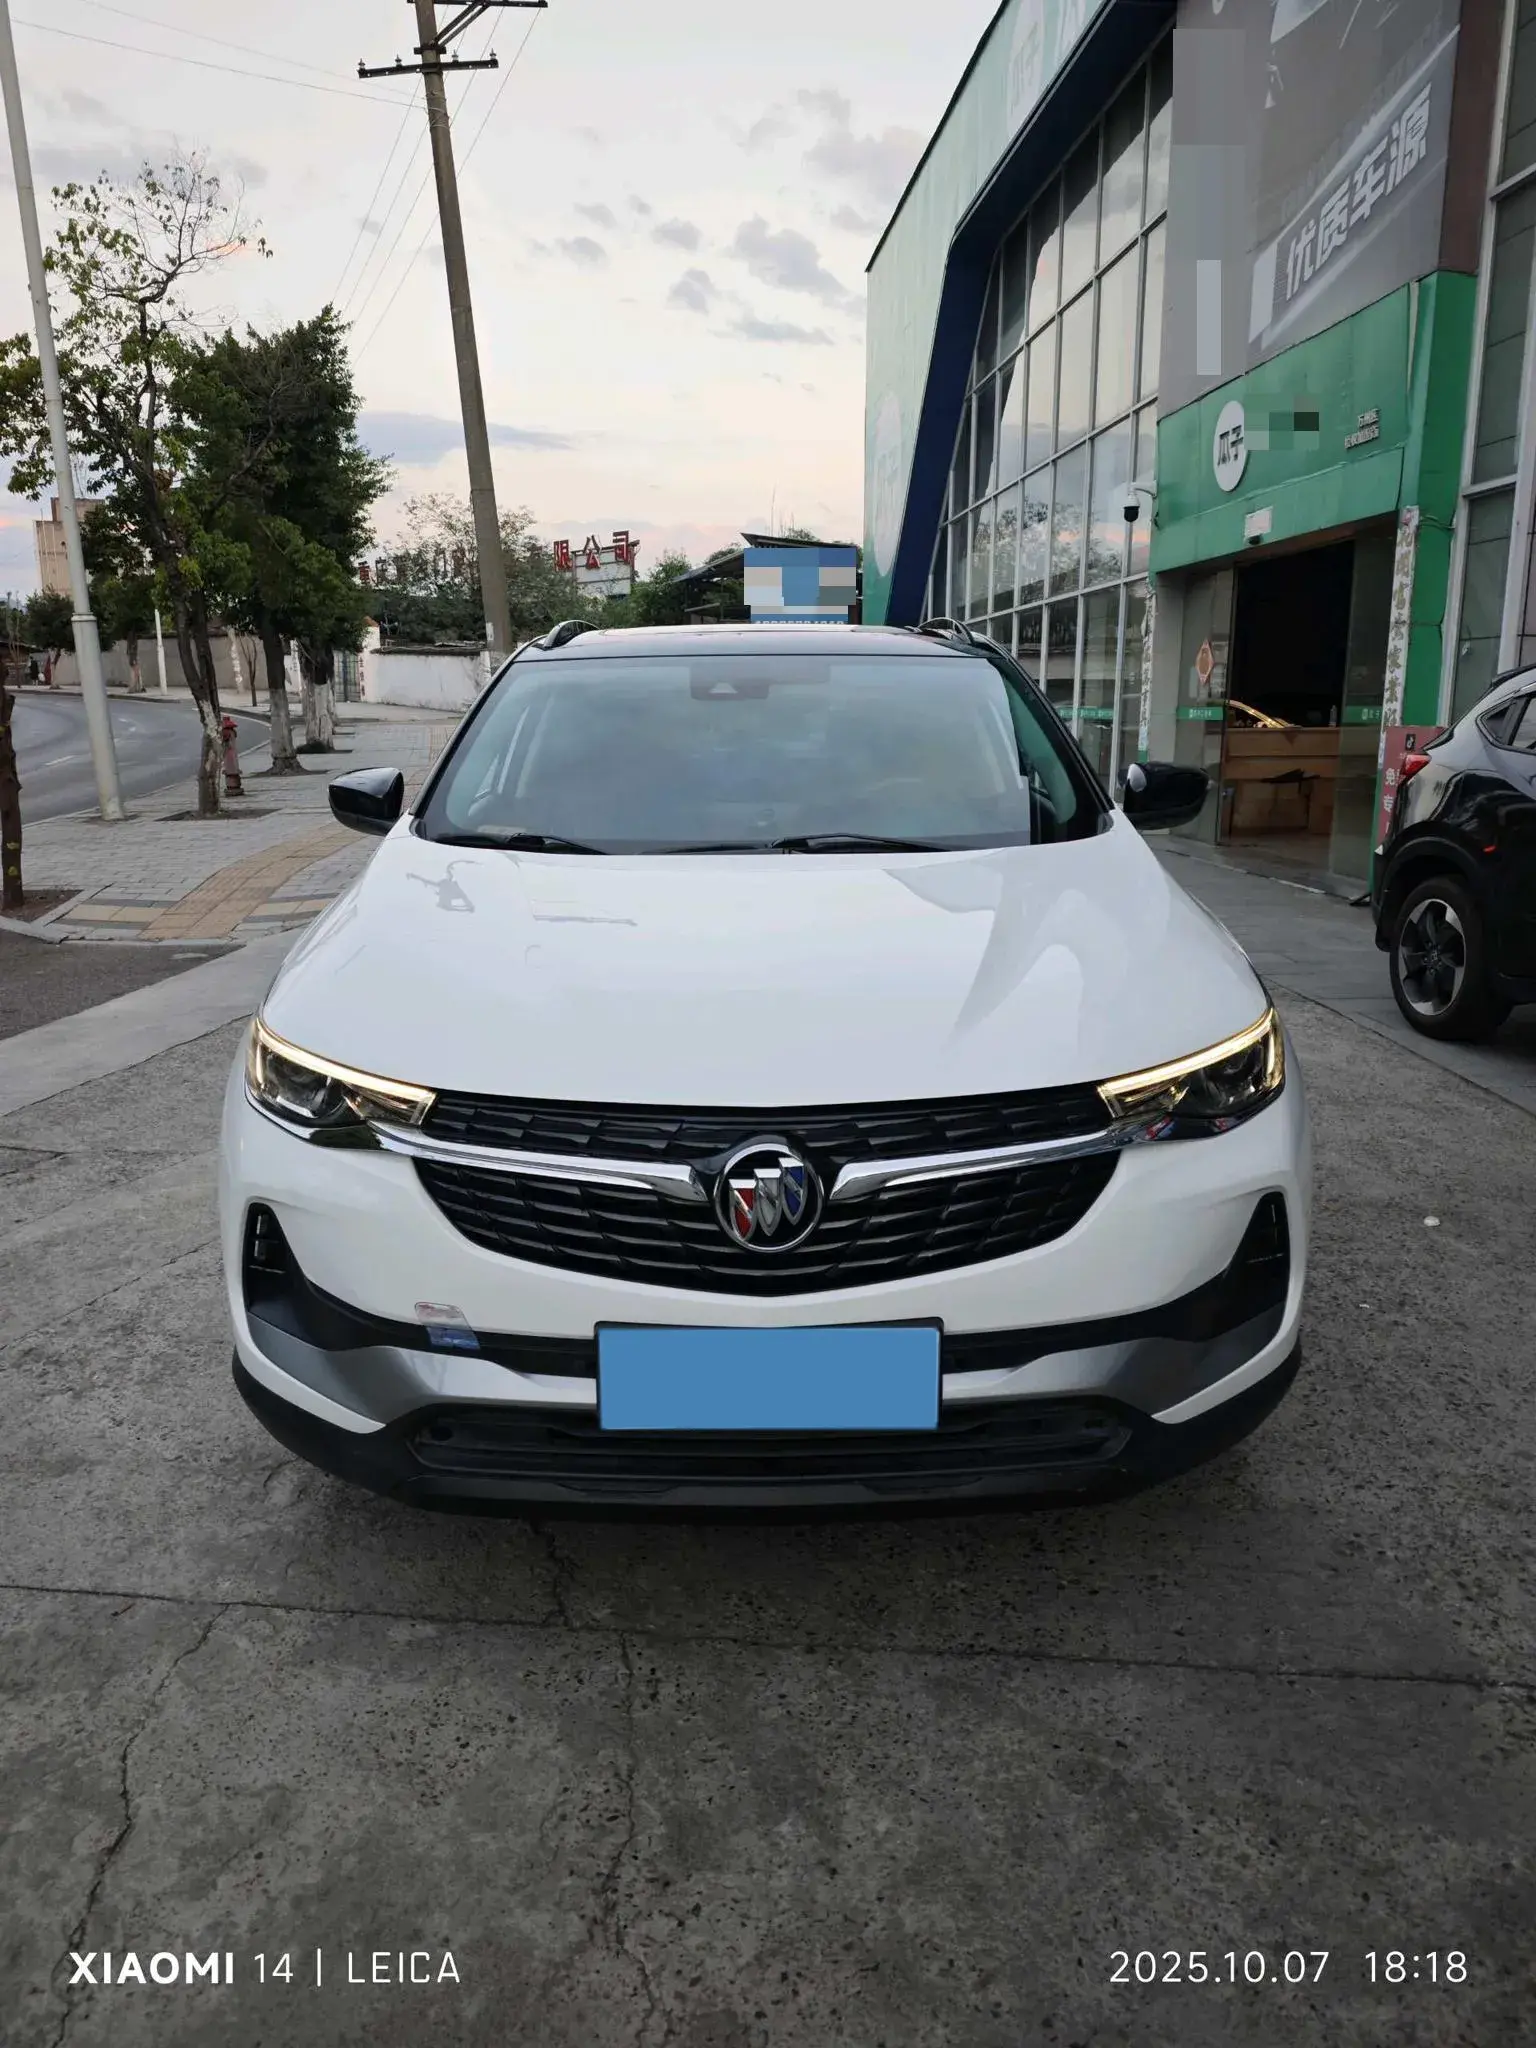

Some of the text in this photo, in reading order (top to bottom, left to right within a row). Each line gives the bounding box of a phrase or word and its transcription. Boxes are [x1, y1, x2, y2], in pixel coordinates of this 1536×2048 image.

[1286, 81, 1432, 301] 优质车源
[1217, 424, 1244, 467] 瓜子
